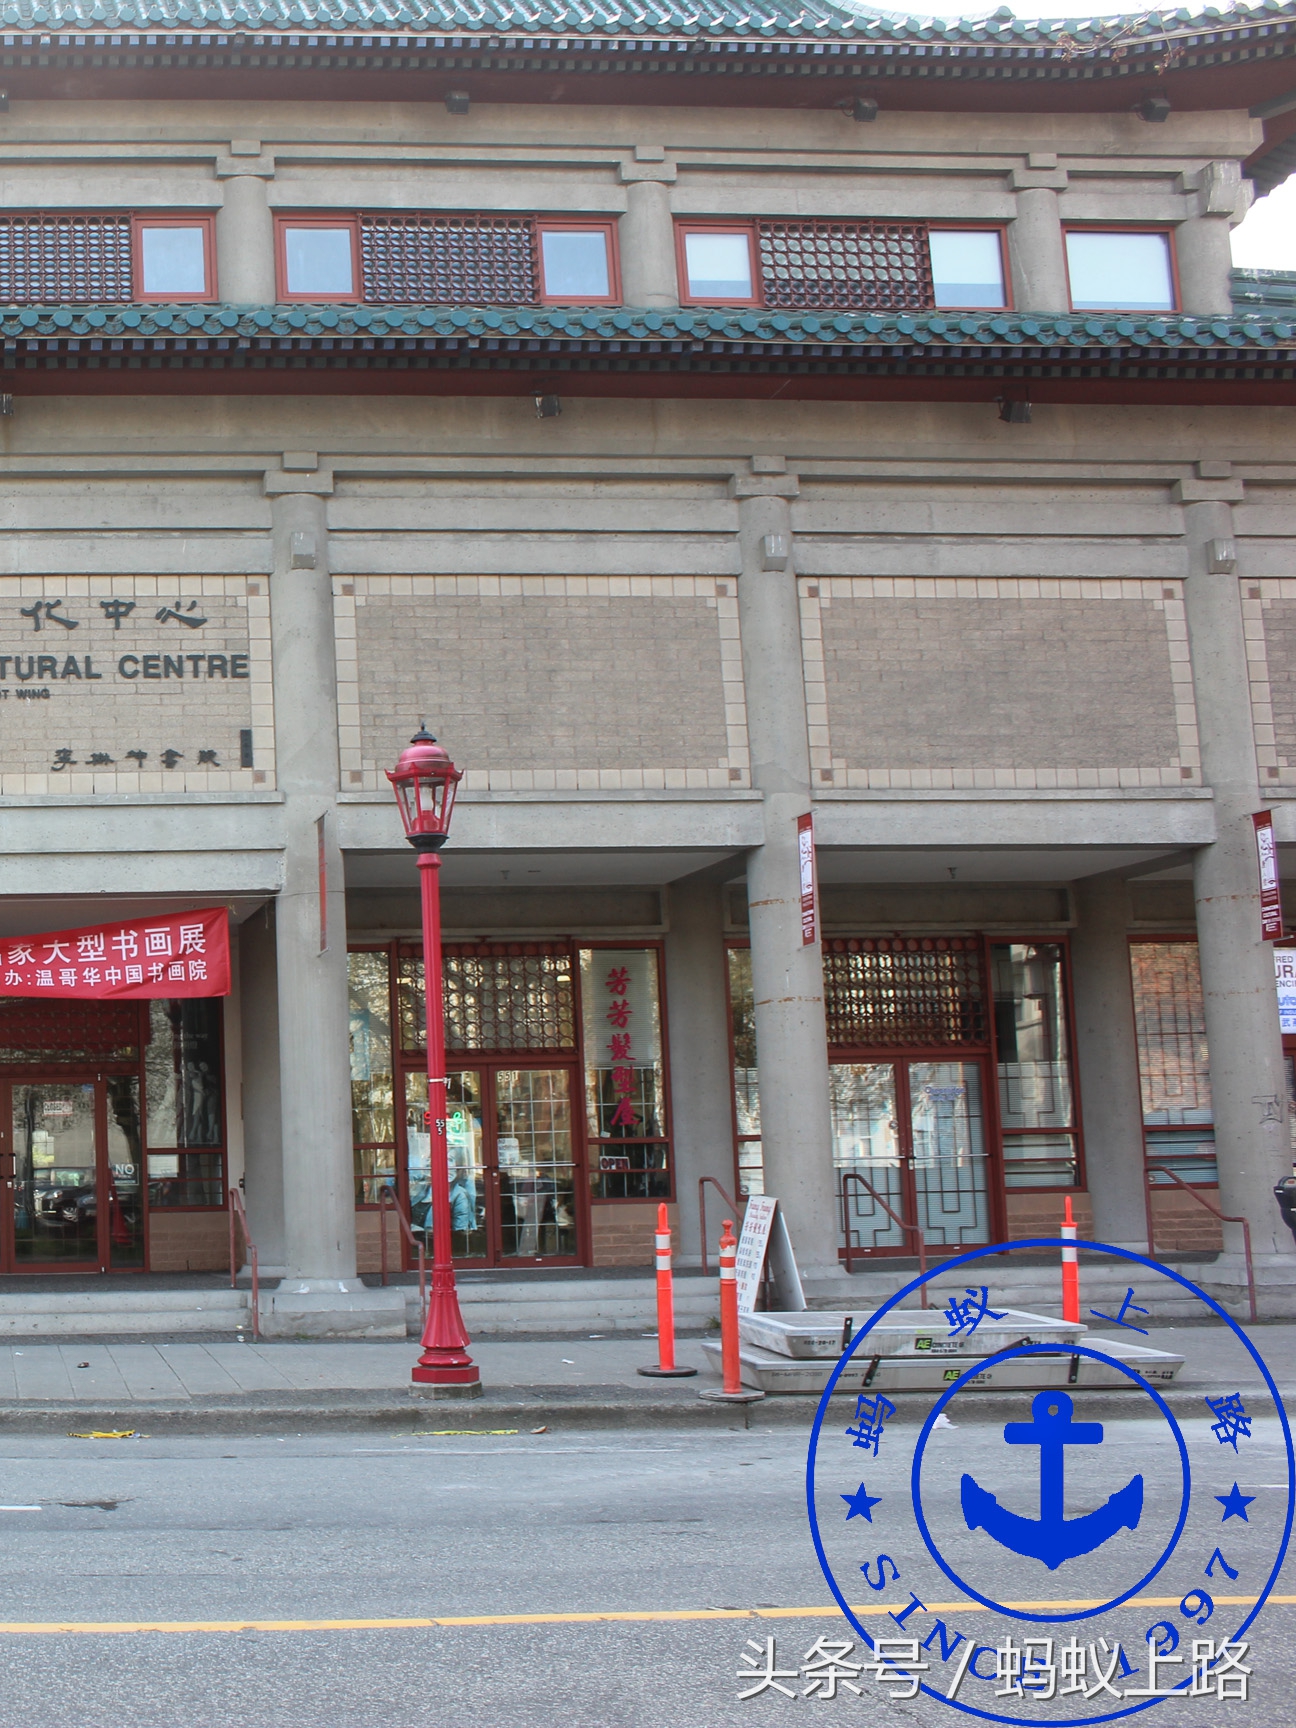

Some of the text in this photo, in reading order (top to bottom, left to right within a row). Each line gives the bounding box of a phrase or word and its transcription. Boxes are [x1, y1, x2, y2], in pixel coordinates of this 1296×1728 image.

[118, 654, 250, 679] CENTRE
[15, 688, 50, 699] WING
[1274, 955, 1294, 963] RED
[601, 1157, 629, 1169] OPEN
[115, 1164, 135, 1175] NO
[916, 1338, 931, 1349] AE
[944, 1370, 960, 1380] AE
